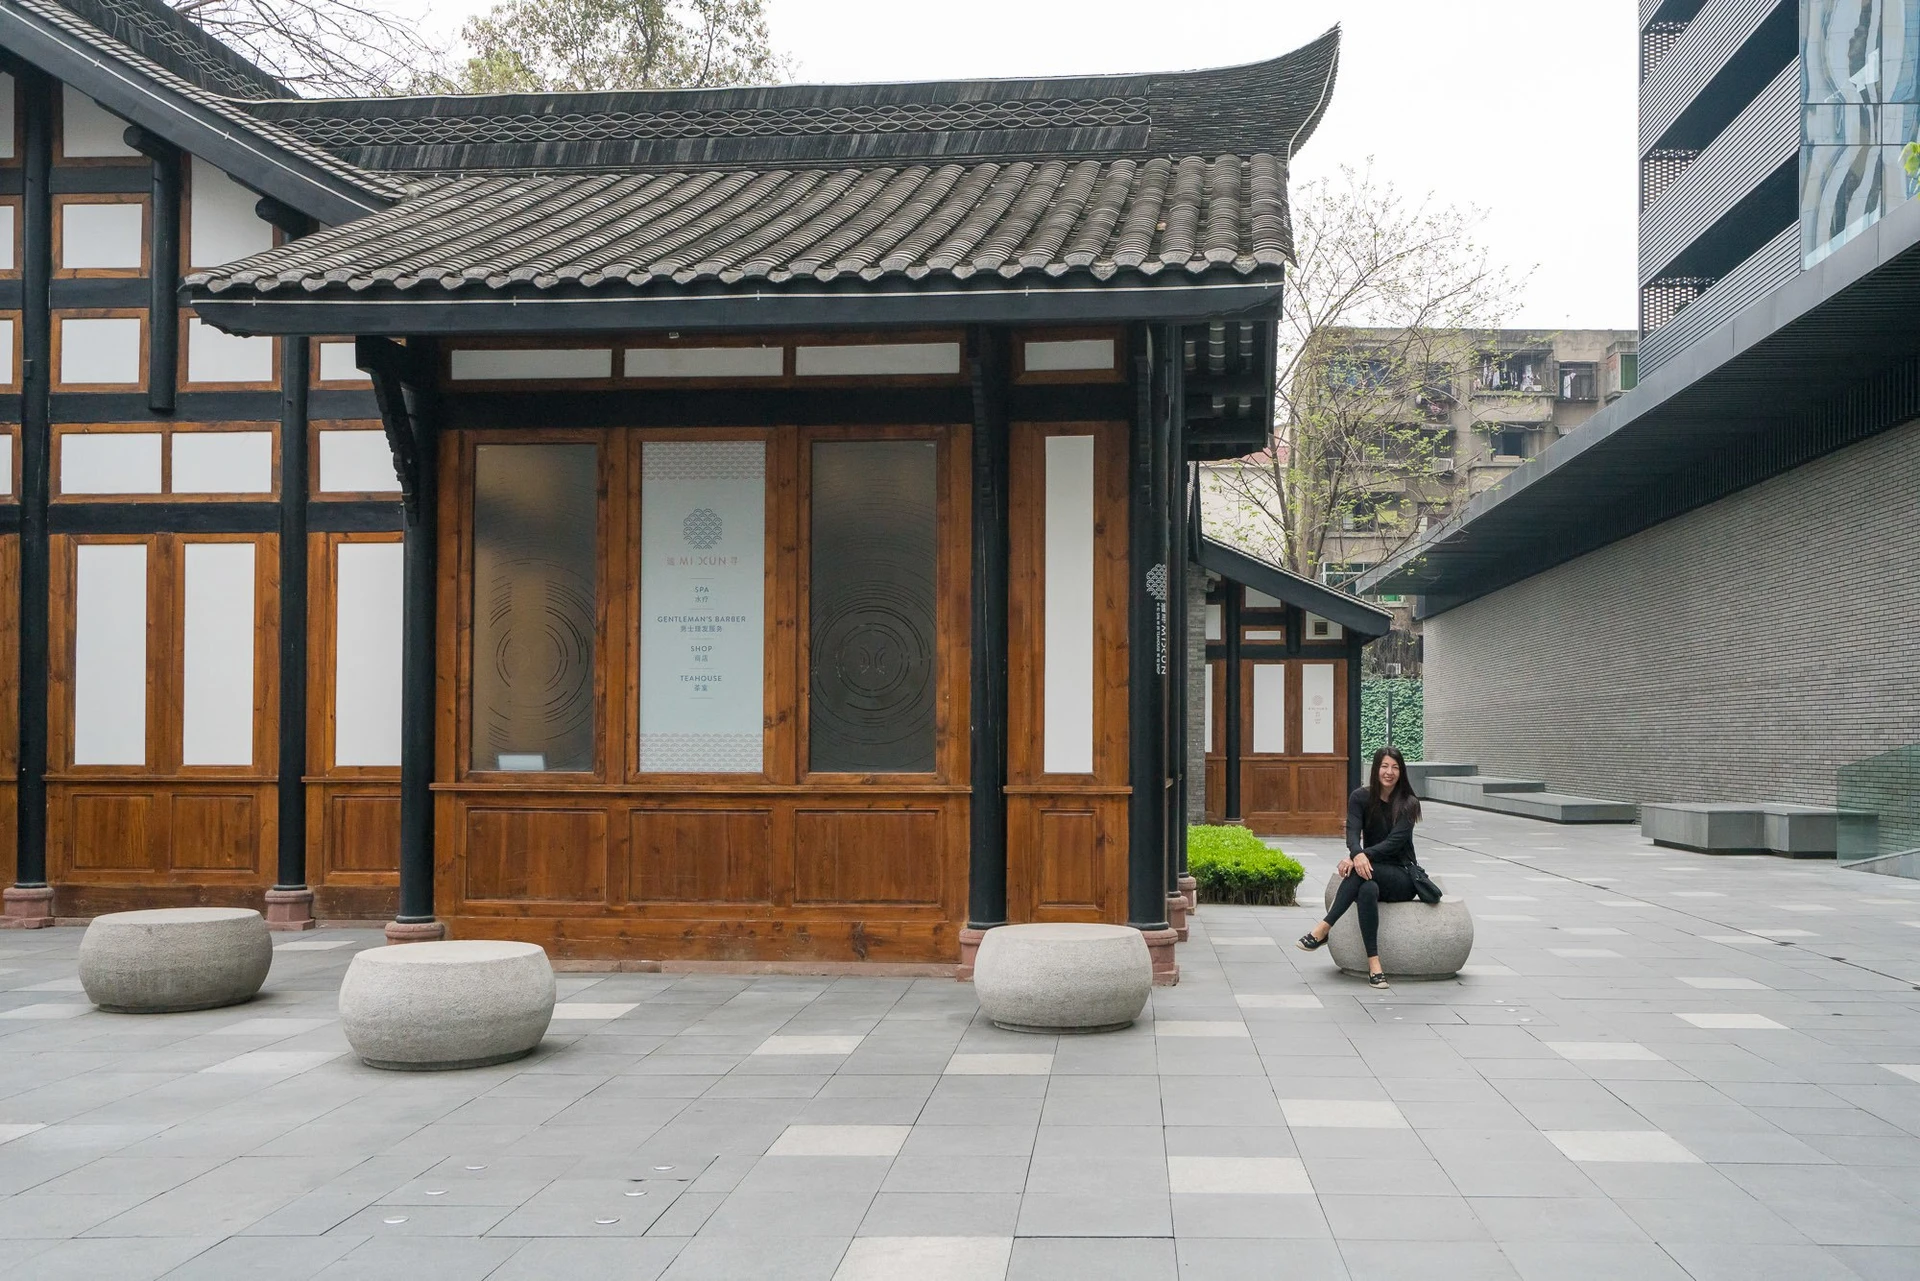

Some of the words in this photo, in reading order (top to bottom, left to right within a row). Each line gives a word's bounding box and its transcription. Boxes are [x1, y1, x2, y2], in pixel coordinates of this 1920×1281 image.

[679, 556, 693, 566] MI
[657, 615, 713, 623] GENTLEMAN'S
[714, 615, 746, 623] BARBER
